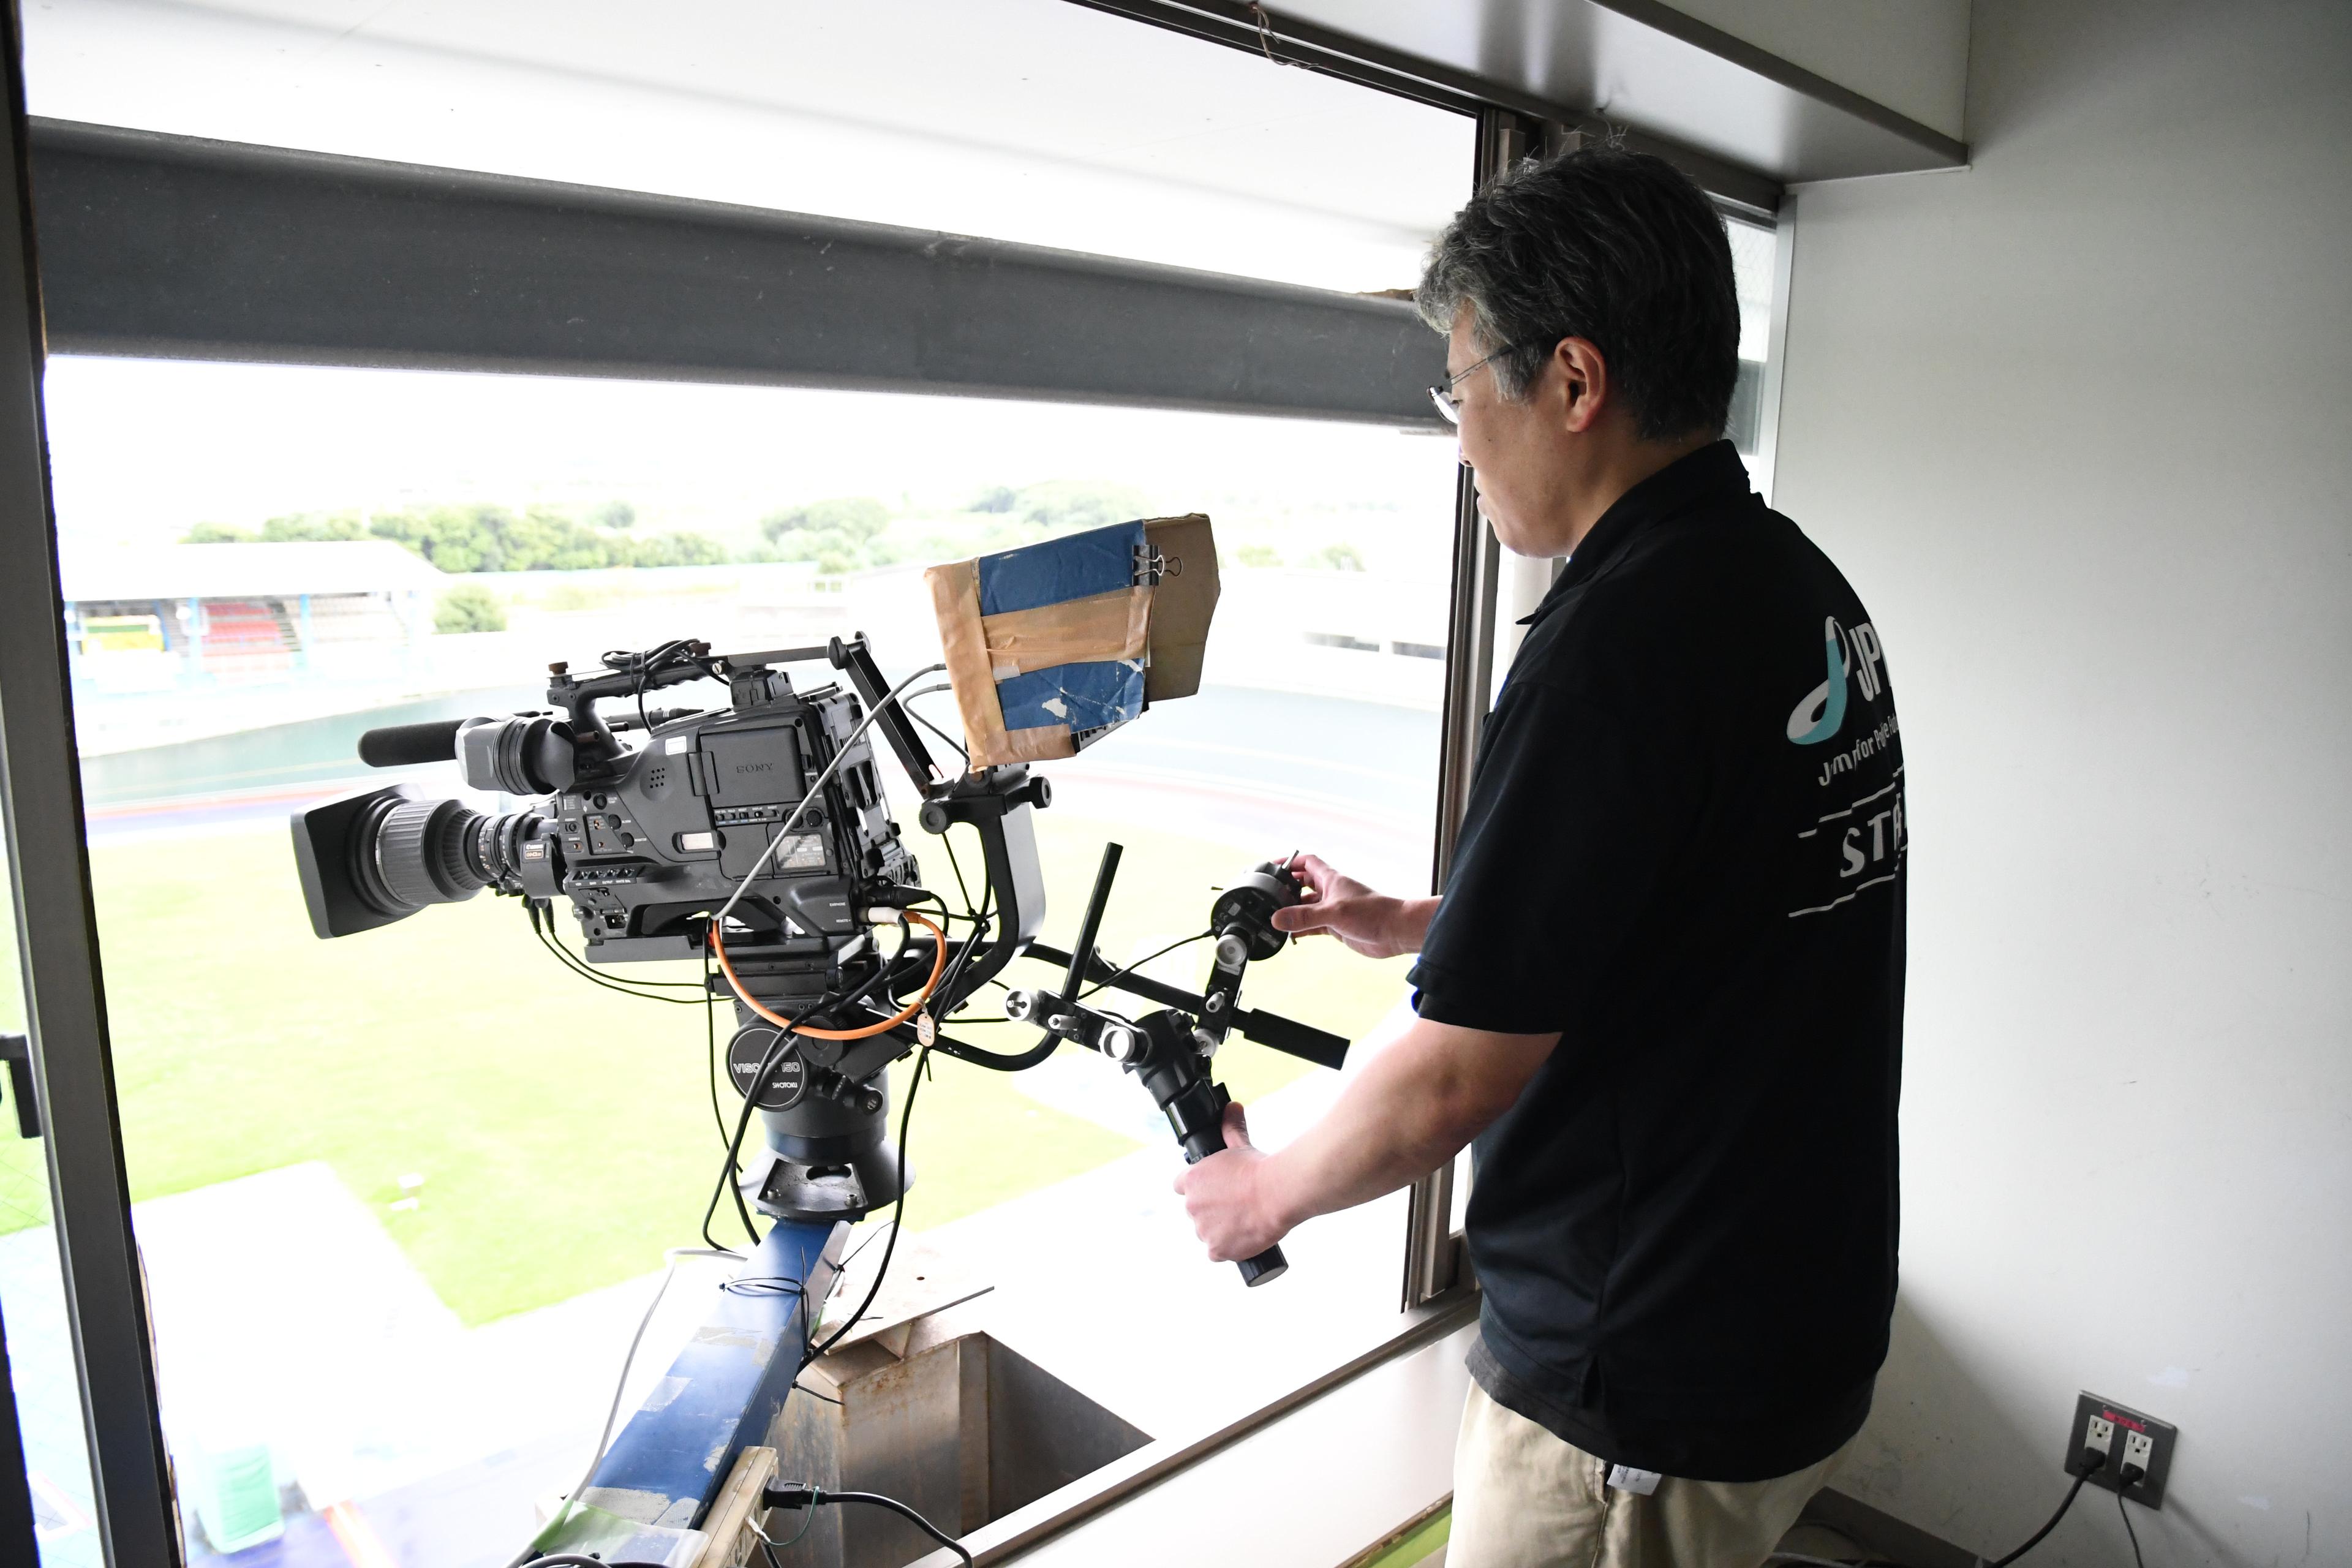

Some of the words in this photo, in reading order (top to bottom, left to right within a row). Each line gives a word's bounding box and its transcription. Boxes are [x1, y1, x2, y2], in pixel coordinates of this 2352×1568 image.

[1849, 622, 1891, 701] JP
[1855, 737, 1874, 761] for
[736, 763, 772, 774] SONY
[1840, 786, 1907, 878] STA
[781, 1062, 800, 1072] 150
